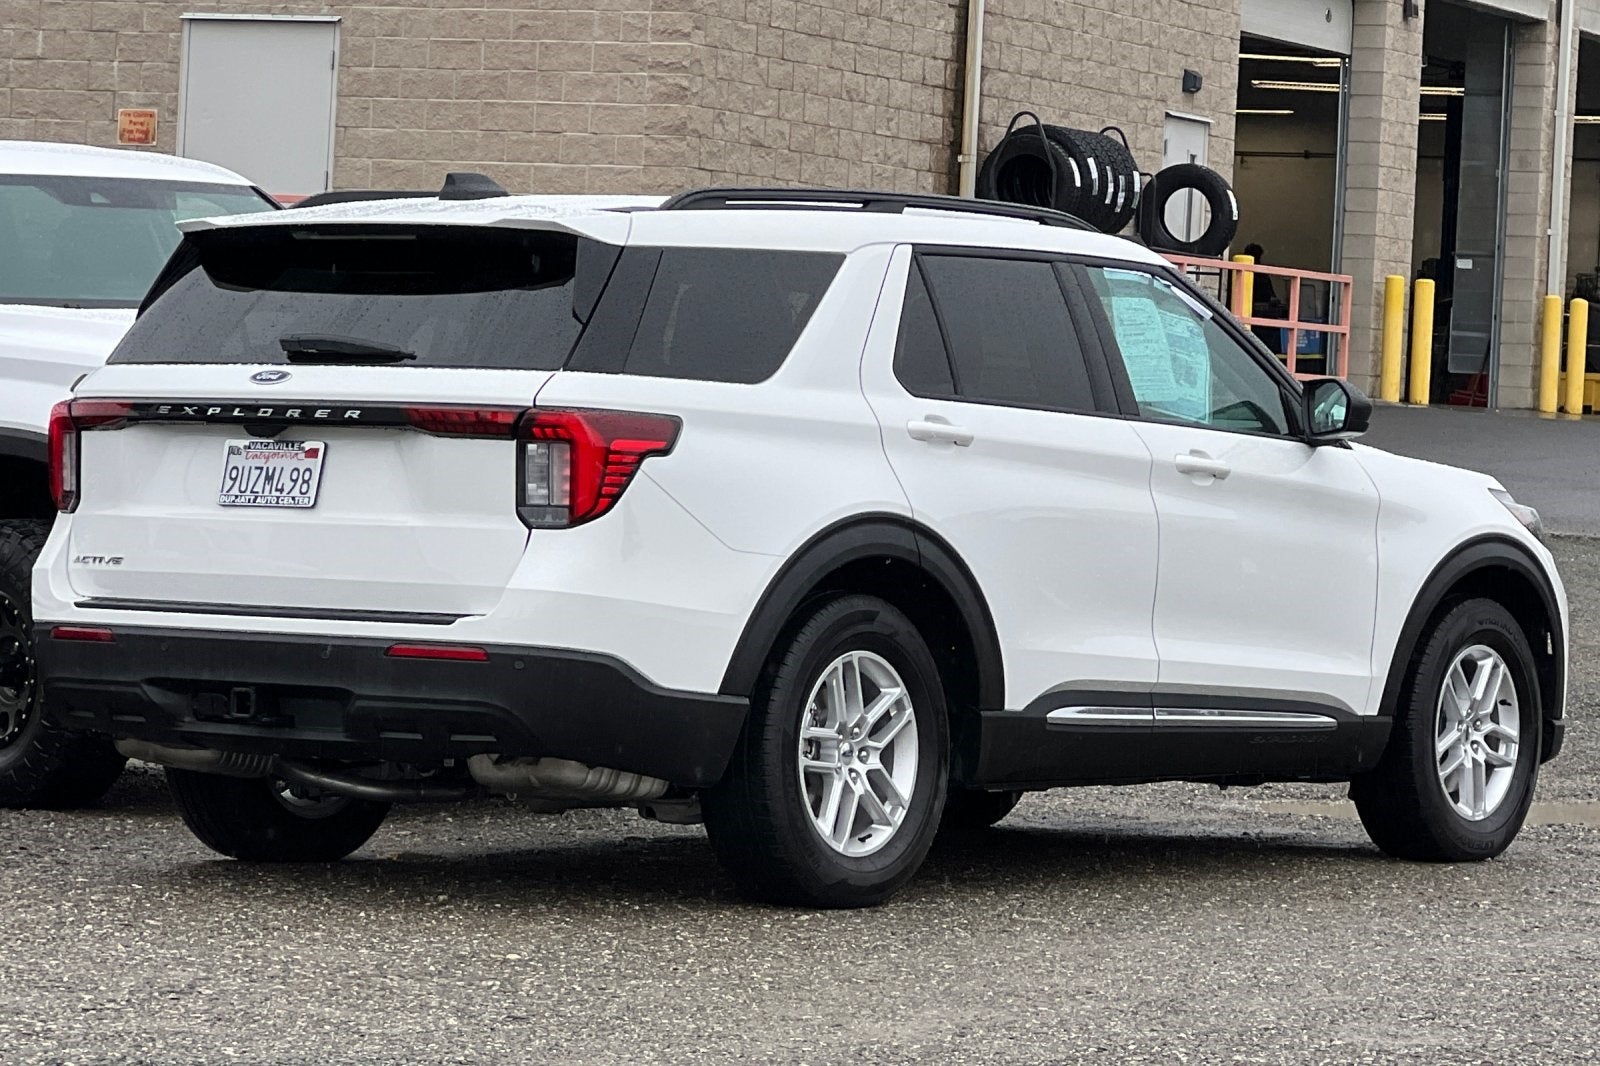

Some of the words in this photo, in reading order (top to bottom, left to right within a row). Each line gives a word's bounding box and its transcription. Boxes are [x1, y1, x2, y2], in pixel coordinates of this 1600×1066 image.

[256, 371, 281, 381] Ford
[157, 405, 361, 418] EXPLORER
[250, 442, 300, 451] VACAVILLE
[245, 451, 300, 465] California
[226, 465, 313, 496] 9UZM498
[255, 496, 277, 504] AUTO
[278, 496, 309, 505] CENTER
[74, 555, 124, 565] ACTIVE
